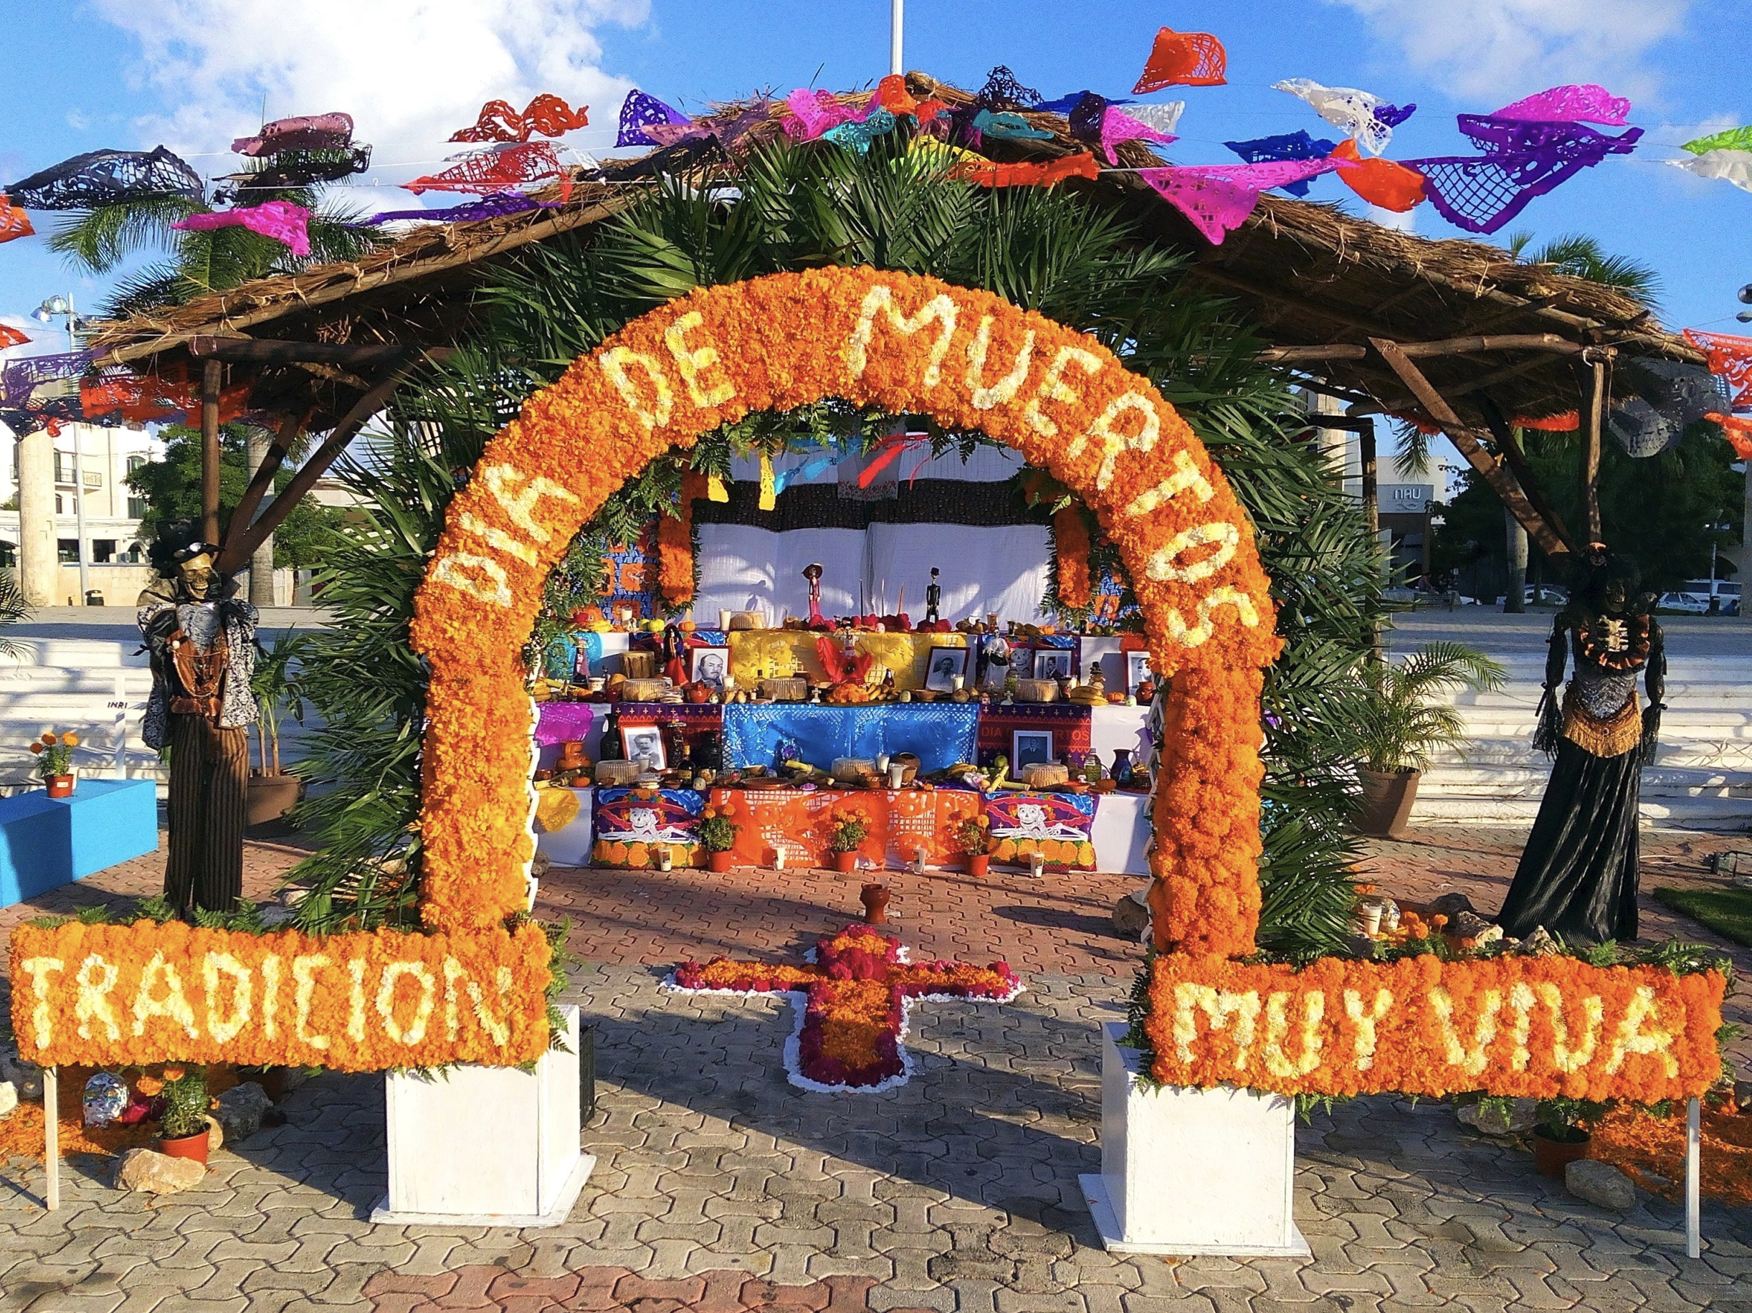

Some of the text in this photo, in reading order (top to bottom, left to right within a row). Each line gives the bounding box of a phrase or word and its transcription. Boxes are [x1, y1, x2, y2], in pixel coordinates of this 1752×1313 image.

[599, 311, 737, 431] DE
[848, 284, 1258, 648] MUERTOS
[107, 701, 128, 709] INRI
[22, 950, 512, 1050] TRADICION
[1173, 981, 1678, 1080] MUY VIVA
